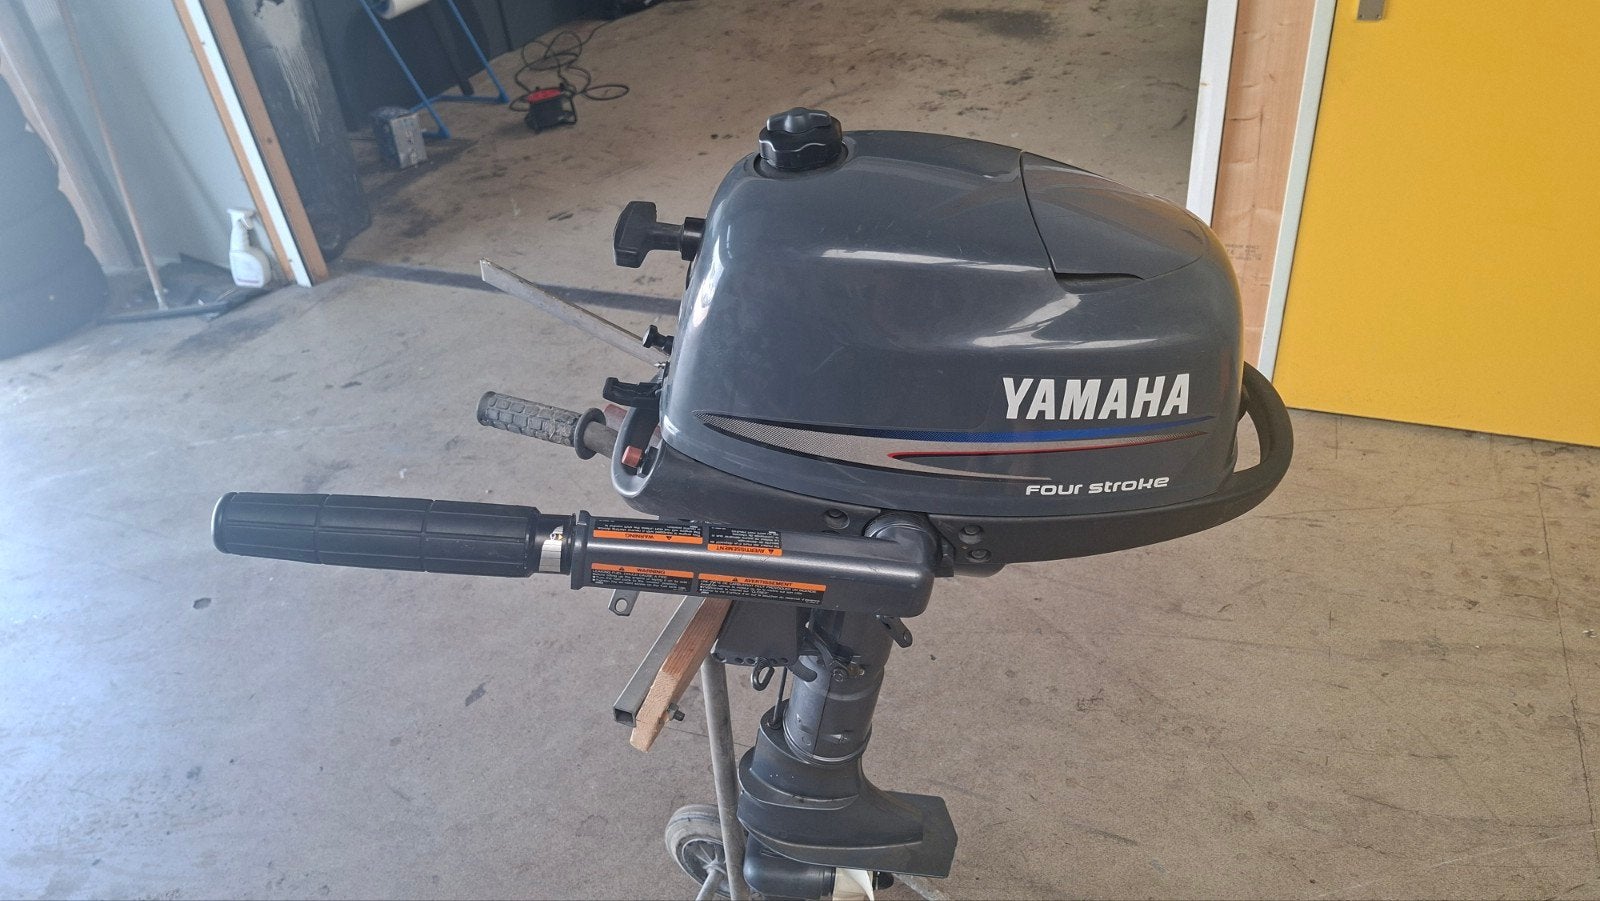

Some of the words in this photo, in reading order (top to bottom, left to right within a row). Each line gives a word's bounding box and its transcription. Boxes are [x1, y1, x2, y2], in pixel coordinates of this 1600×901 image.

[1002, 373, 1190, 420] YAMAHA
[715, 545, 765, 554] AVERTISSEMENT
[636, 567, 666, 575] WARNING
[744, 577, 792, 587] AVERTISSEMENT
